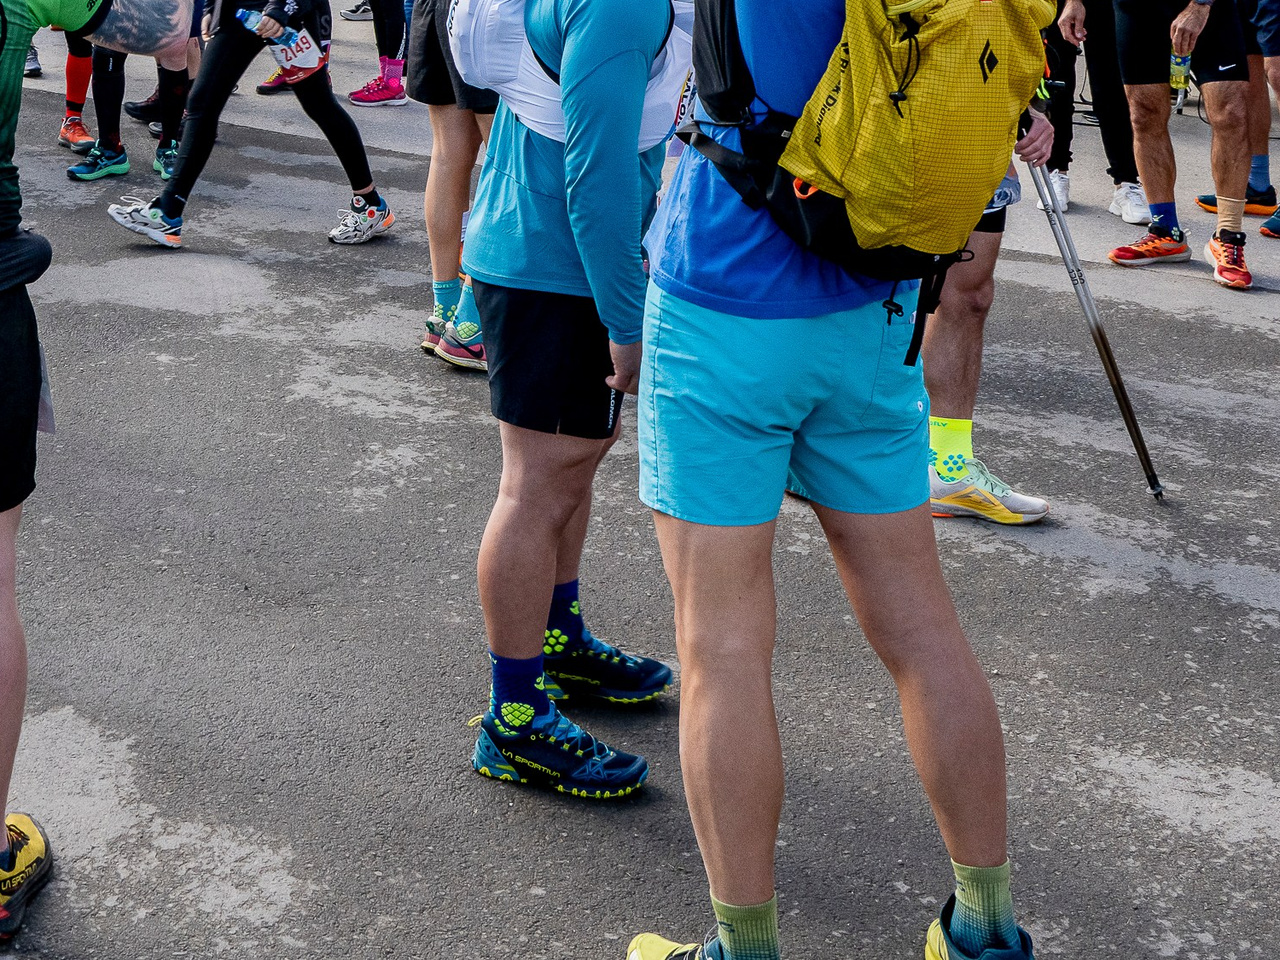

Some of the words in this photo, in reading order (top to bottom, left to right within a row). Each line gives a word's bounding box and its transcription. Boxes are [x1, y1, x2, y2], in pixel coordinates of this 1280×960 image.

[280, 34, 313, 63] 2149
[608, 388, 617, 429] ALOMON
[514, 754, 561, 778] SPORTIVA
